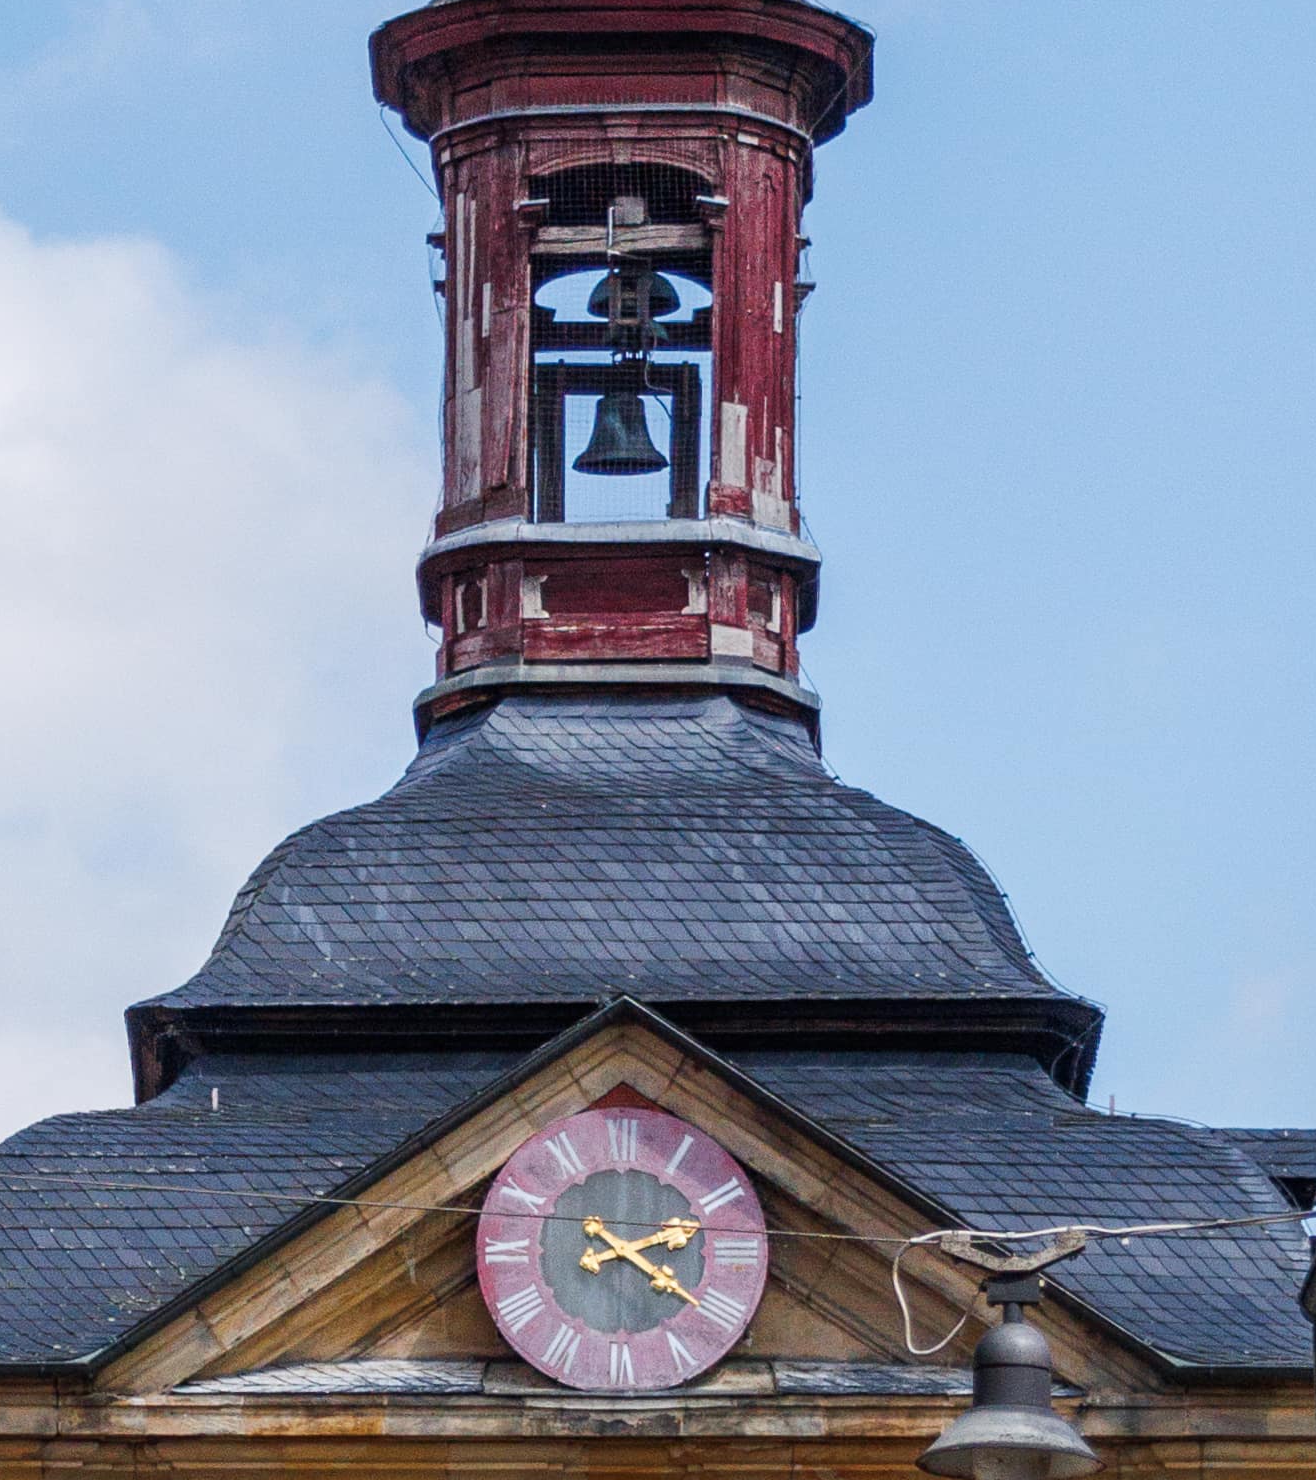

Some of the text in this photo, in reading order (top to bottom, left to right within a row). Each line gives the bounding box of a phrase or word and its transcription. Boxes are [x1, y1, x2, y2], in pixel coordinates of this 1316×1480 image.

[545, 1132, 585, 1178] XI
[606, 1119, 638, 1161] XII
[666, 1134, 693, 1174] I
[500, 1177, 547, 1213] X
[699, 1176, 744, 1214] II
[485, 1237, 529, 1264] IX
[714, 1238, 758, 1265] III
[496, 1283, 545, 1335] VIII
[541, 1323, 582, 1374] VII
[610, 1342, 637, 1385] VI
[666, 1331, 699, 1373] V
